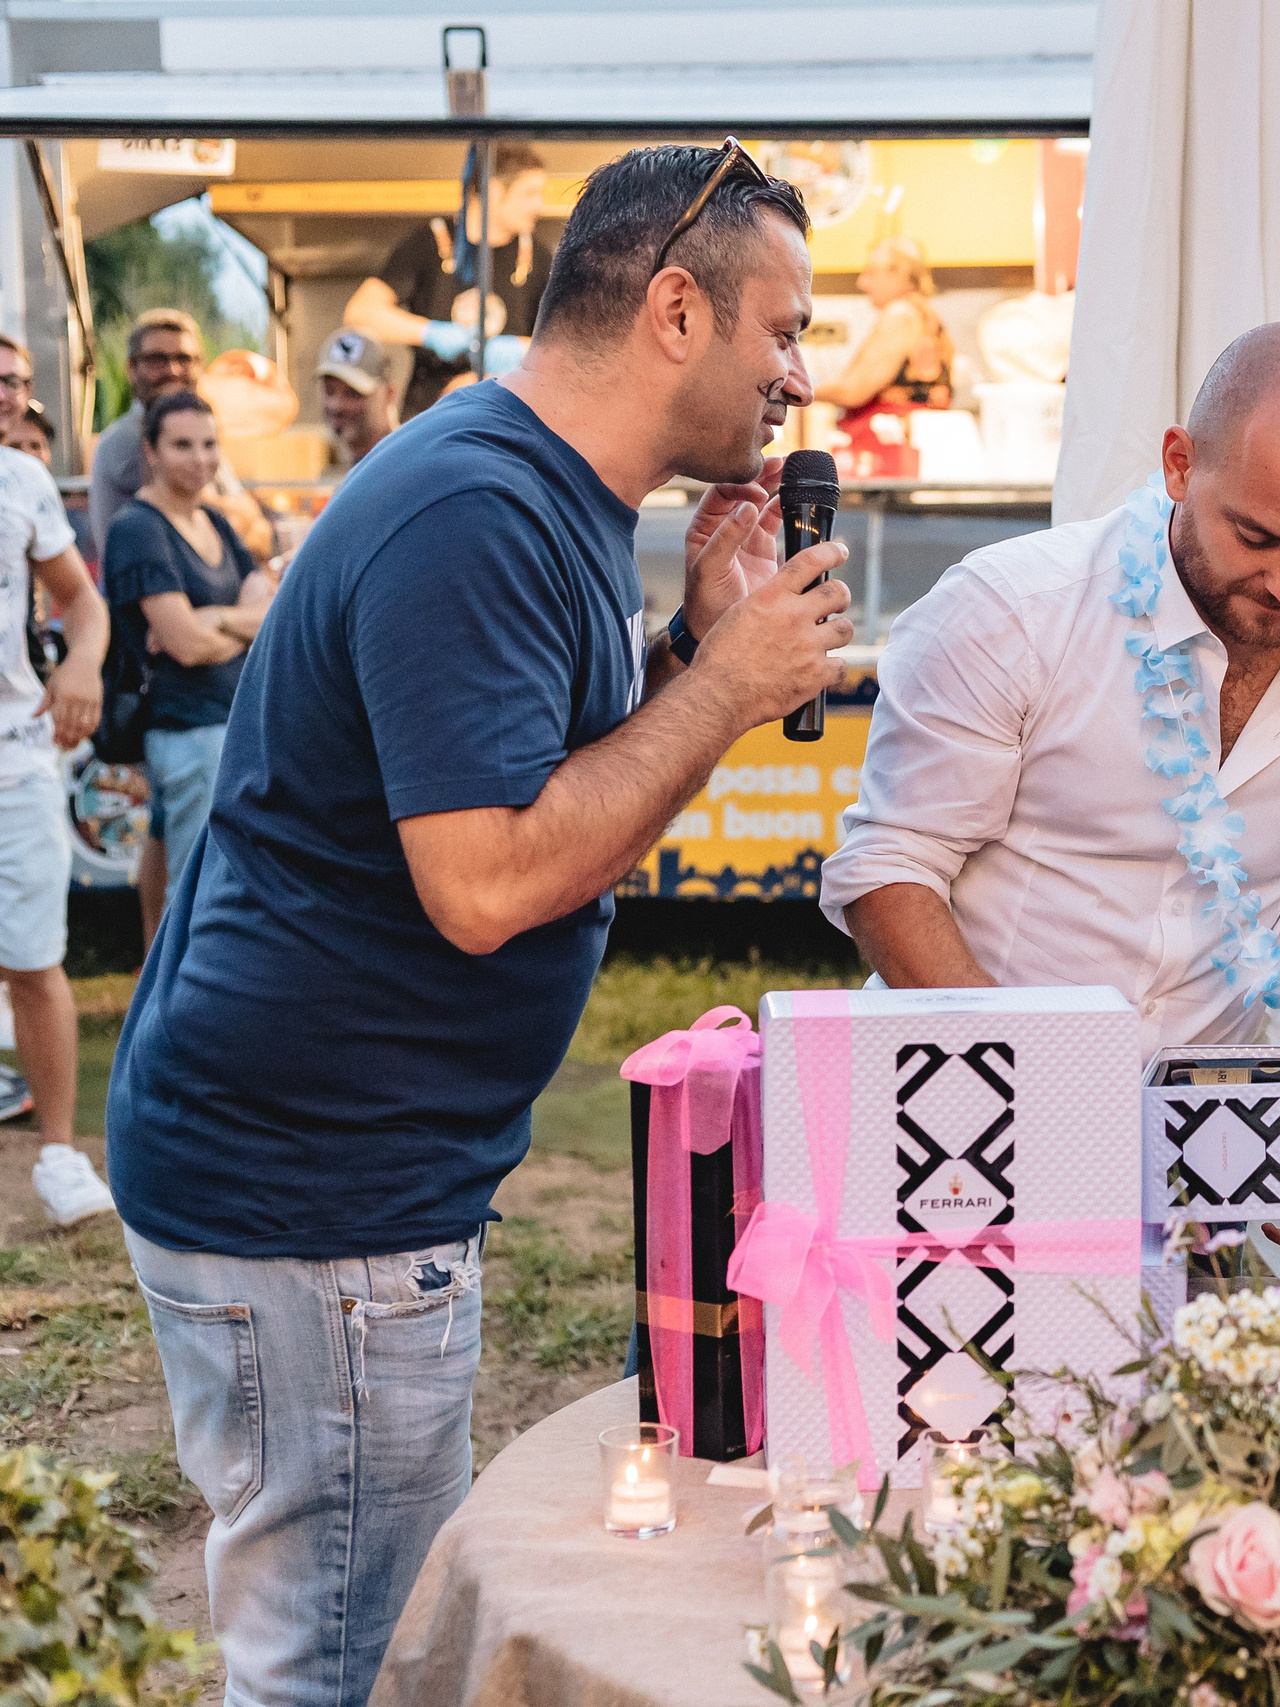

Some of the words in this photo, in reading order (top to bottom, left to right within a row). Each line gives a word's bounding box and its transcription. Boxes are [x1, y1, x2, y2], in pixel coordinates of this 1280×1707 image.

[708, 765, 820, 803] possa
[723, 802, 822, 840] buon
[919, 1196, 992, 1210] FERRARI
